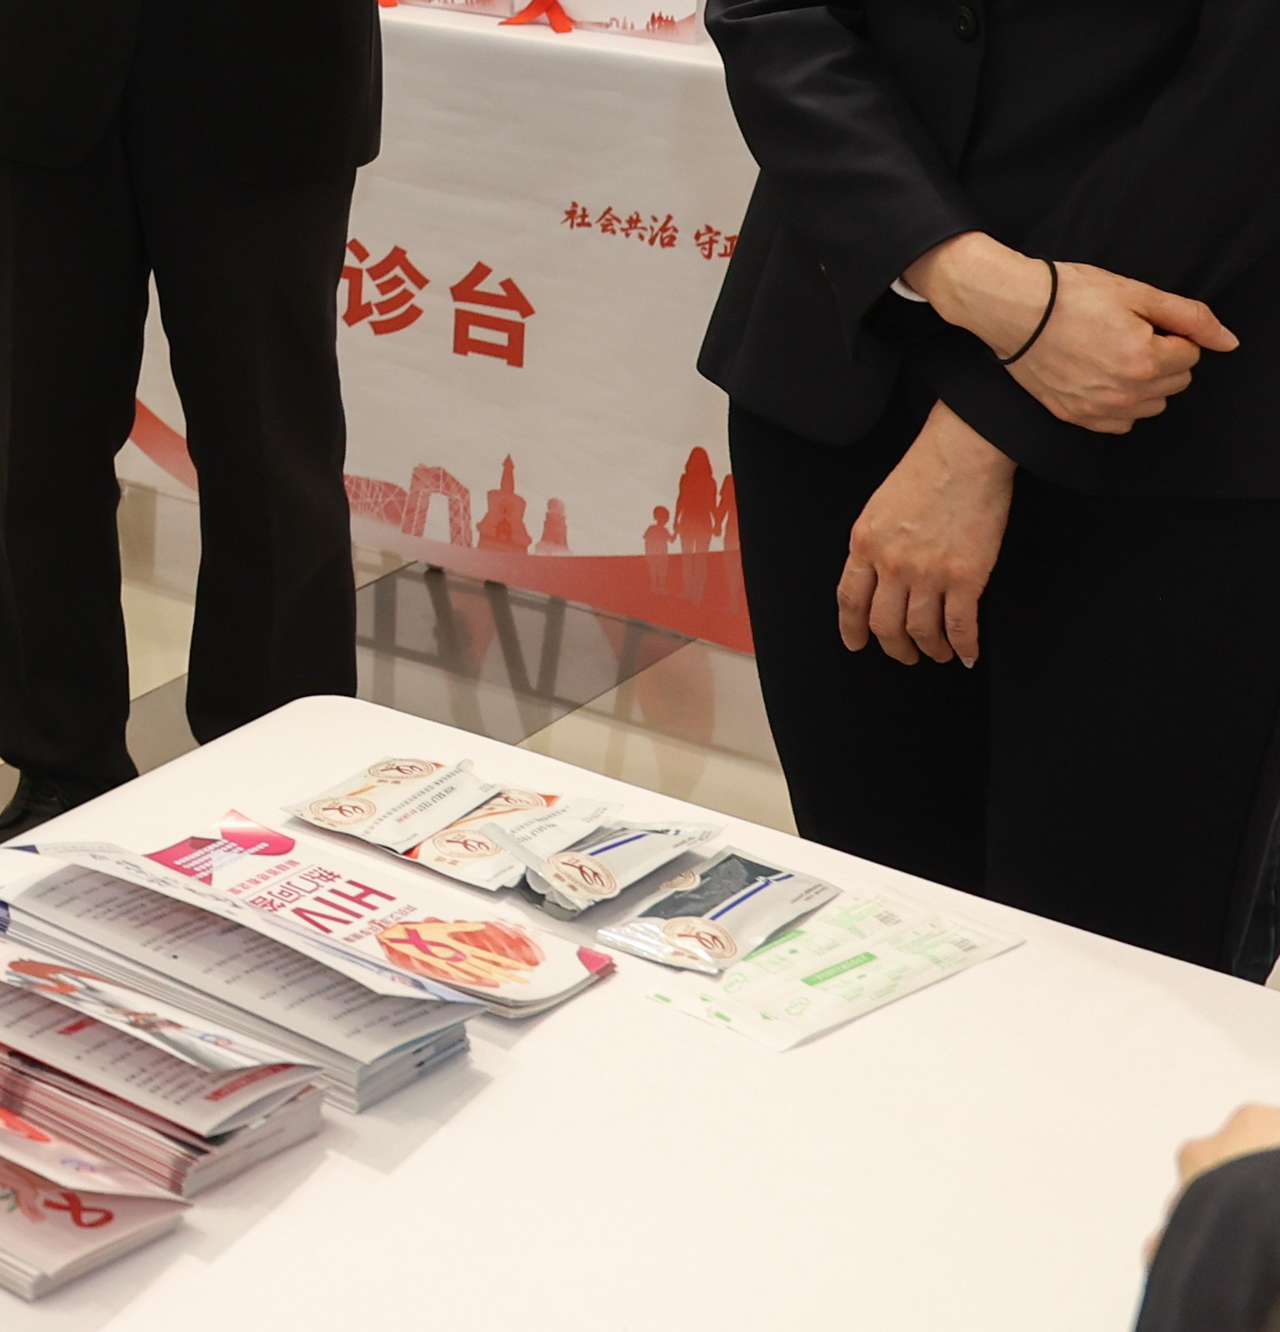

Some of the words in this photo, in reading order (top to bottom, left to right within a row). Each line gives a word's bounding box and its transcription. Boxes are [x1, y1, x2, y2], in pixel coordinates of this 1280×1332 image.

[561, 201, 678, 248] 社会共治
[245, 864, 346, 914] 热门问答
[281, 878, 398, 934] HIV
